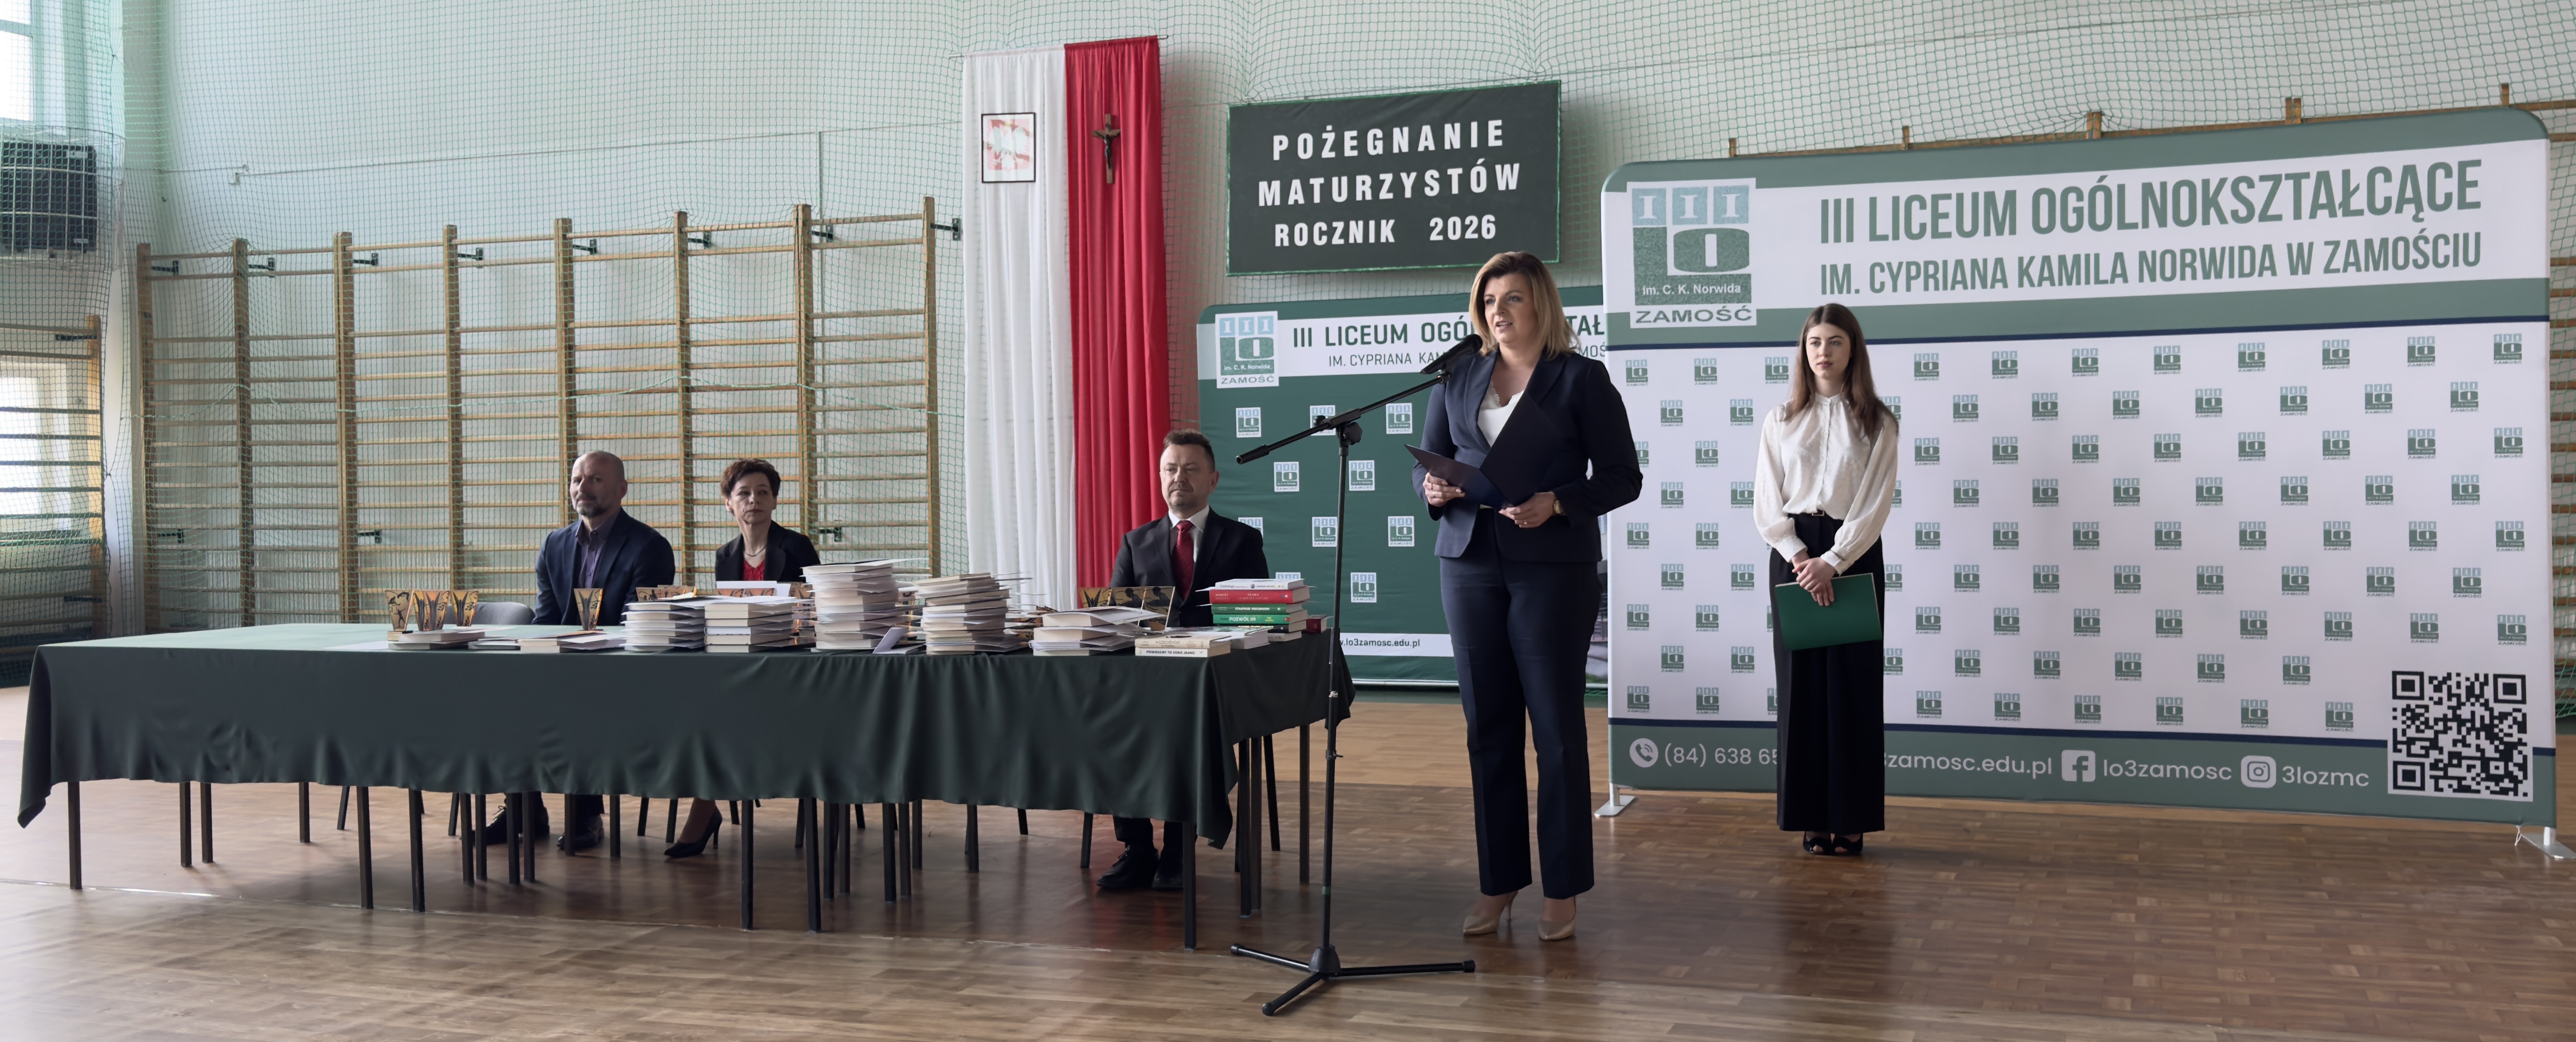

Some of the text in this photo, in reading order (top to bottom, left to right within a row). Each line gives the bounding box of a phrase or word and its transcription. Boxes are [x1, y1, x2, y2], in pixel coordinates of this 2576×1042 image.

[1273, 119, 1502, 160] POŻEGNANIE
[1259, 159, 1519, 206] MATURZYSTÓW
[1635, 190, 1745, 222] III
[1821, 159, 2482, 244] III LICEUM OGÓLNOKSZTAŁCĄCE
[1275, 214, 1496, 247] ROCZNIK 2026
[1821, 228, 2481, 295] IM. CYPRIANA KAMILA NORWIDA W ZAMOŚCIU
[1663, 285, 1675, 295] C.
[1678, 284, 1690, 295] K.
[1693, 283, 1741, 294] Norwida
[1221, 317, 1272, 335] III
[1636, 305, 1752, 323] ZAMOŚĆ
[1293, 327, 1312, 347] III
[1325, 323, 1408, 346] LICEUM
[1329, 355, 1346, 367] IM.
[1350, 353, 1412, 366] CYPRIANA
[1221, 375, 1274, 384] ZAMOŚĆ
[1665, 743, 1706, 767] (84)
[1714, 748, 1752, 764] 638
[1885, 753, 2051, 779] zamosc.edu.pl
[2104, 759, 2232, 780] lo3zamosc
[2282, 766, 2369, 787] 3lozmc
